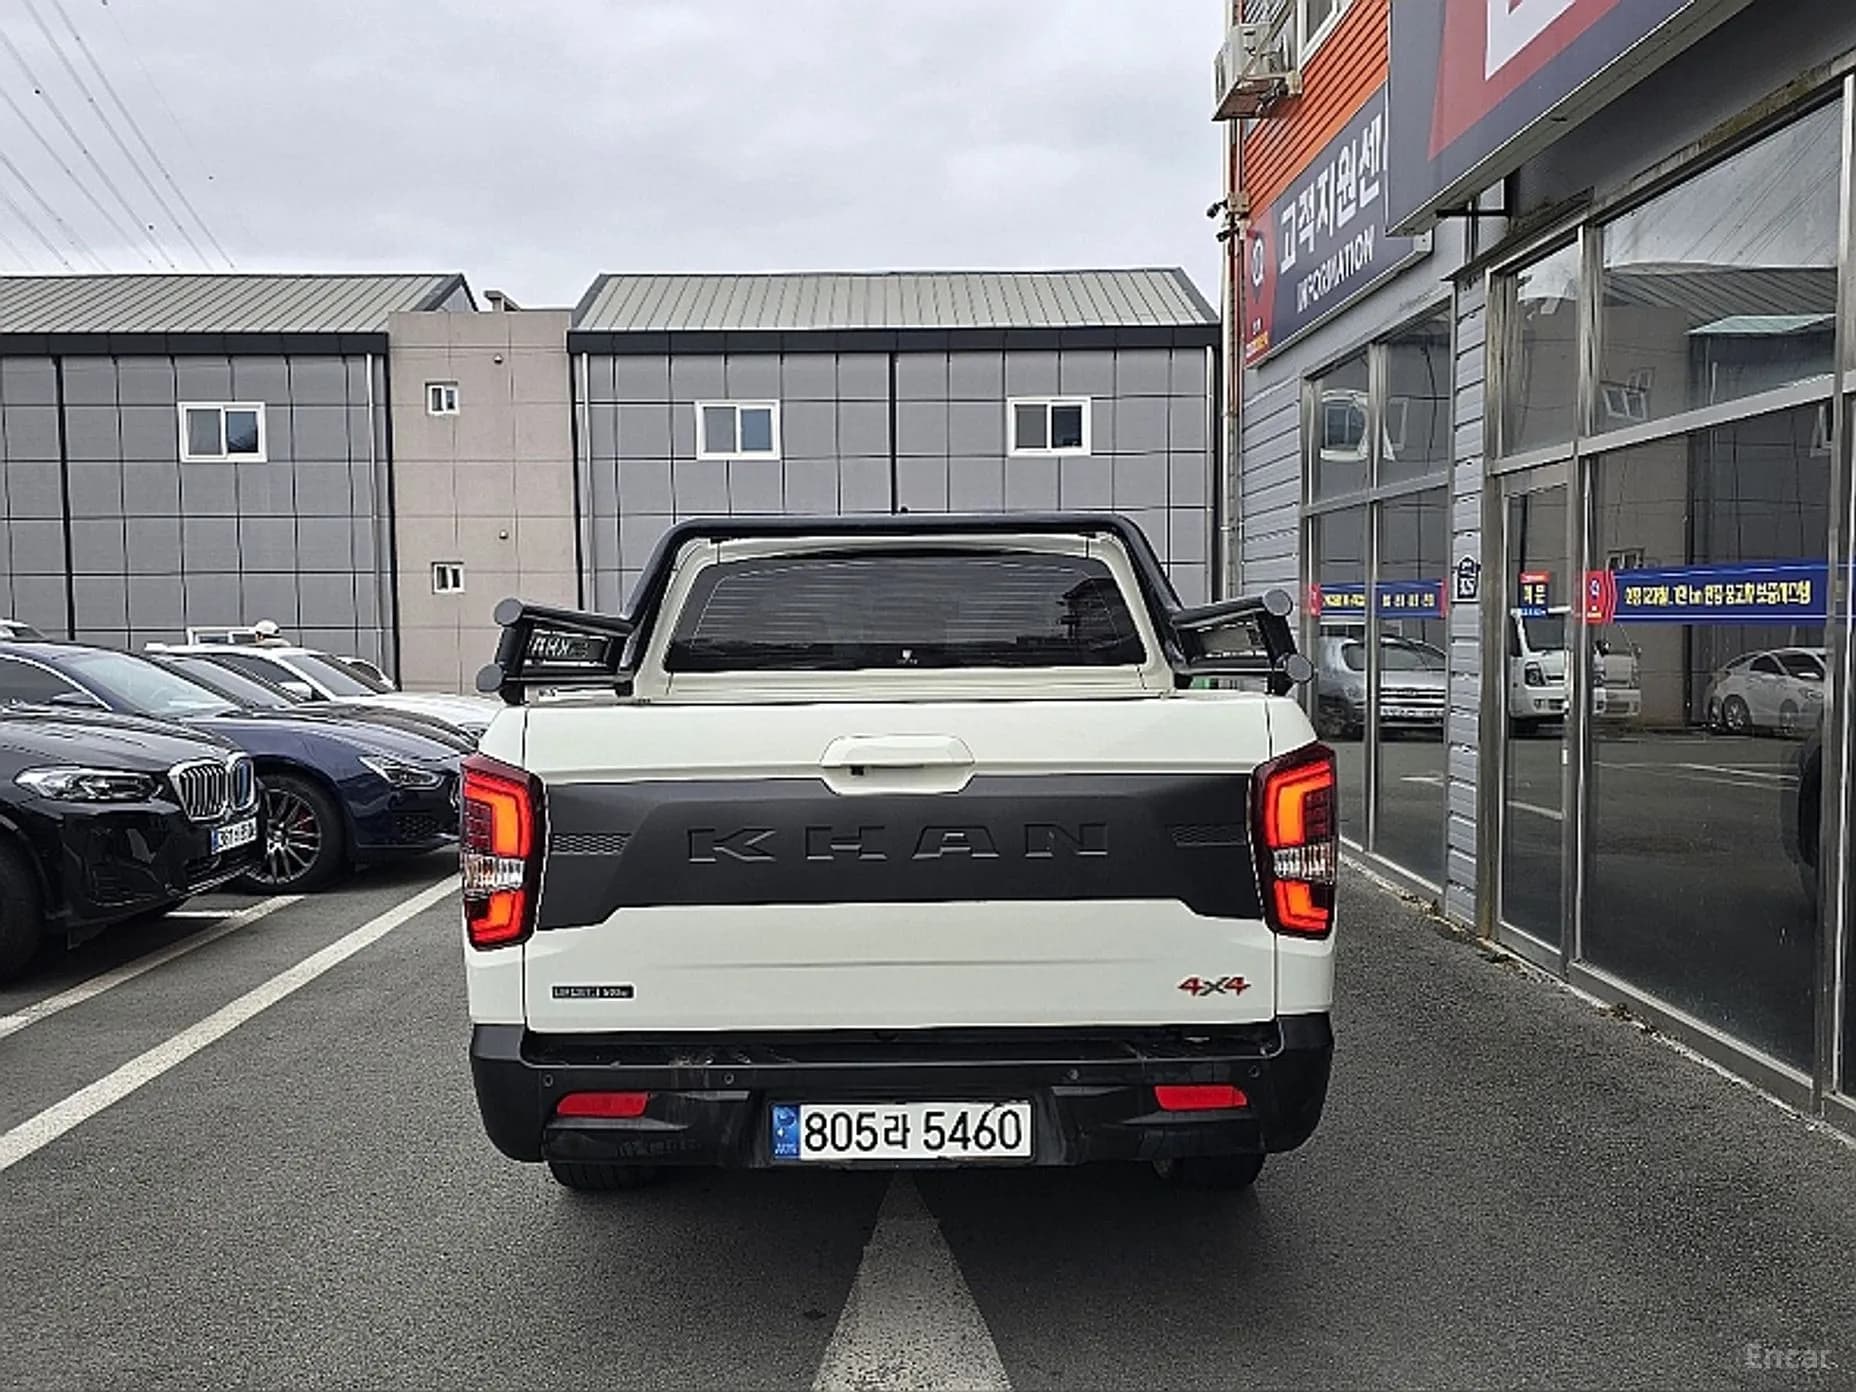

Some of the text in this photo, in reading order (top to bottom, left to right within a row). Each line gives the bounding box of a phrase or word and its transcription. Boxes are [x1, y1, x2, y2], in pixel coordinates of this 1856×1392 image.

[1281, 112, 1387, 274] 고객지원센
[1297, 224, 1375, 314] INFORMATION
[688, 823, 1108, 862] KHAN
[805, 1109, 1022, 1152] 805라 5460
